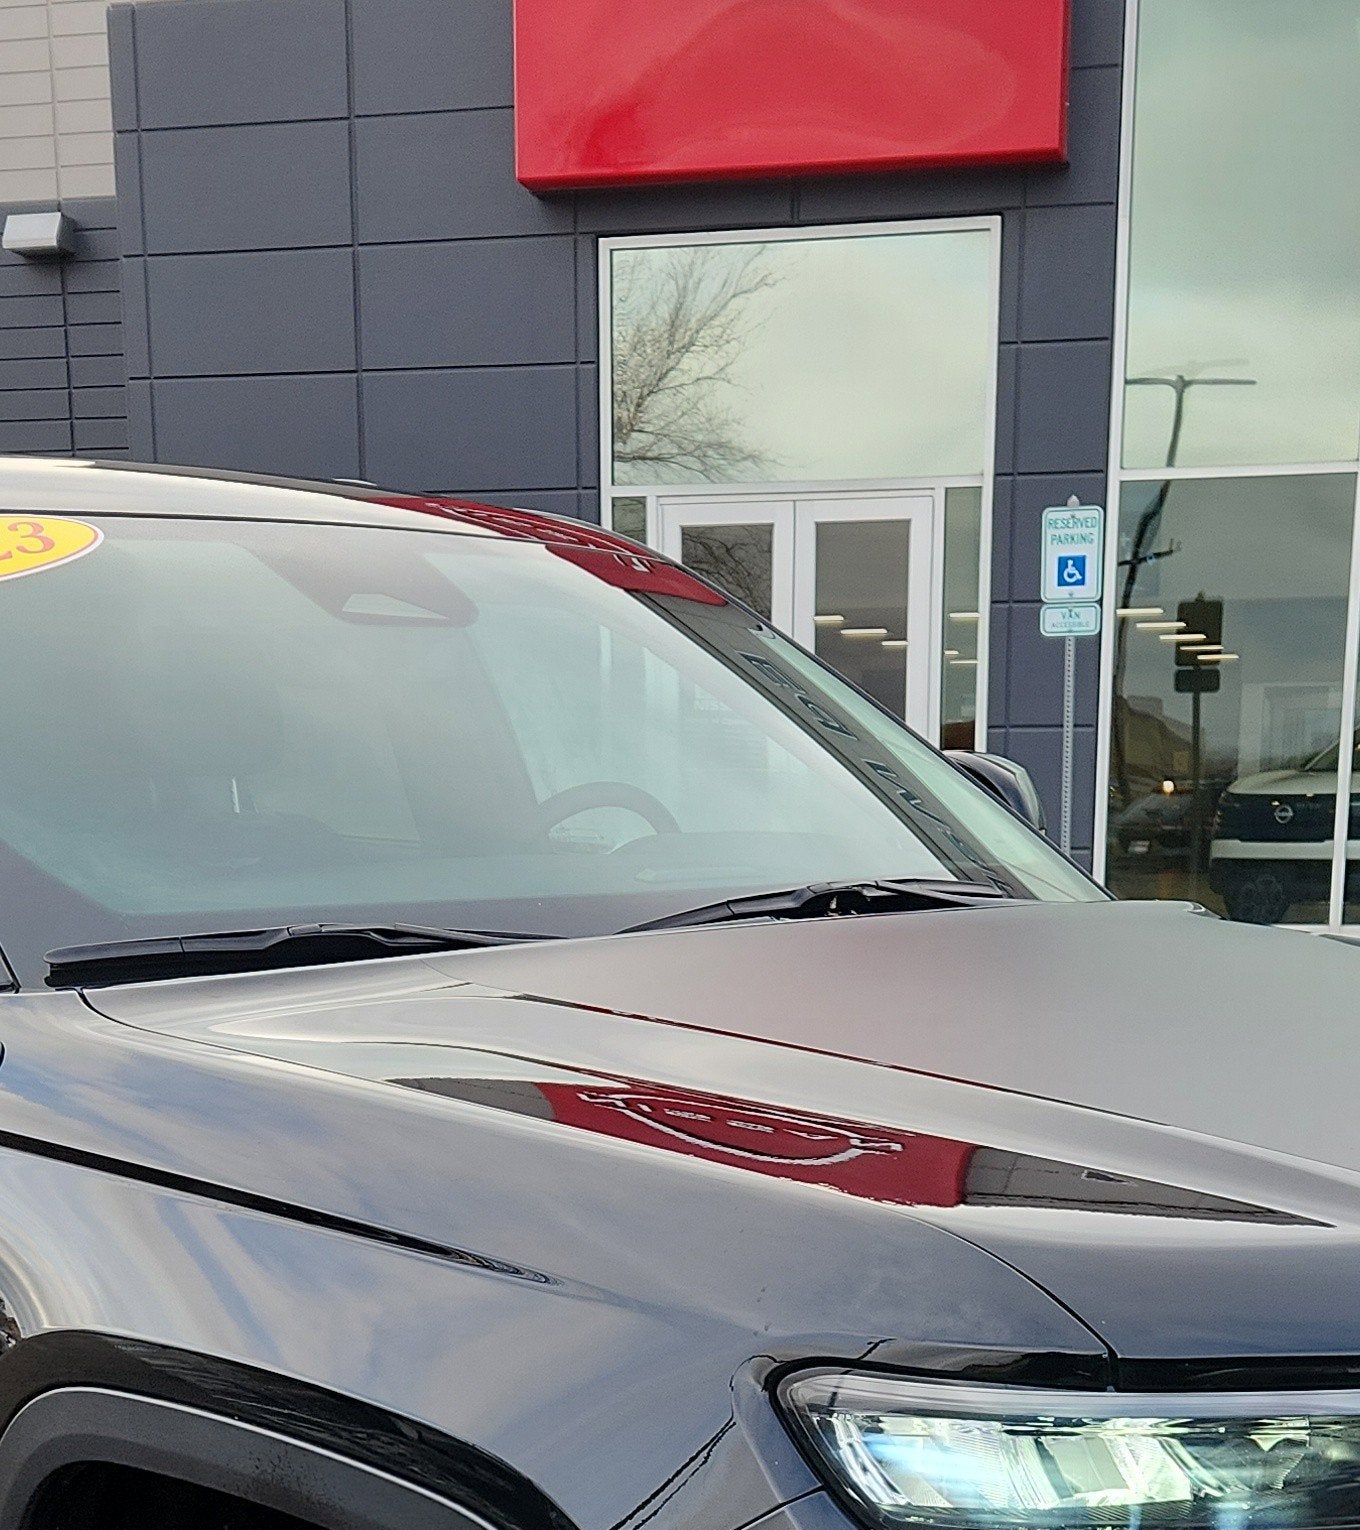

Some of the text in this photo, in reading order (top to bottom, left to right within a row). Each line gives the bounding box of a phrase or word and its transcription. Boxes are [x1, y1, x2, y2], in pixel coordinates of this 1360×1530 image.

[1047, 516, 1098, 530] RESERVED
[1050, 532, 1095, 546] PARKING
[1061, 611, 1081, 620] VAN
